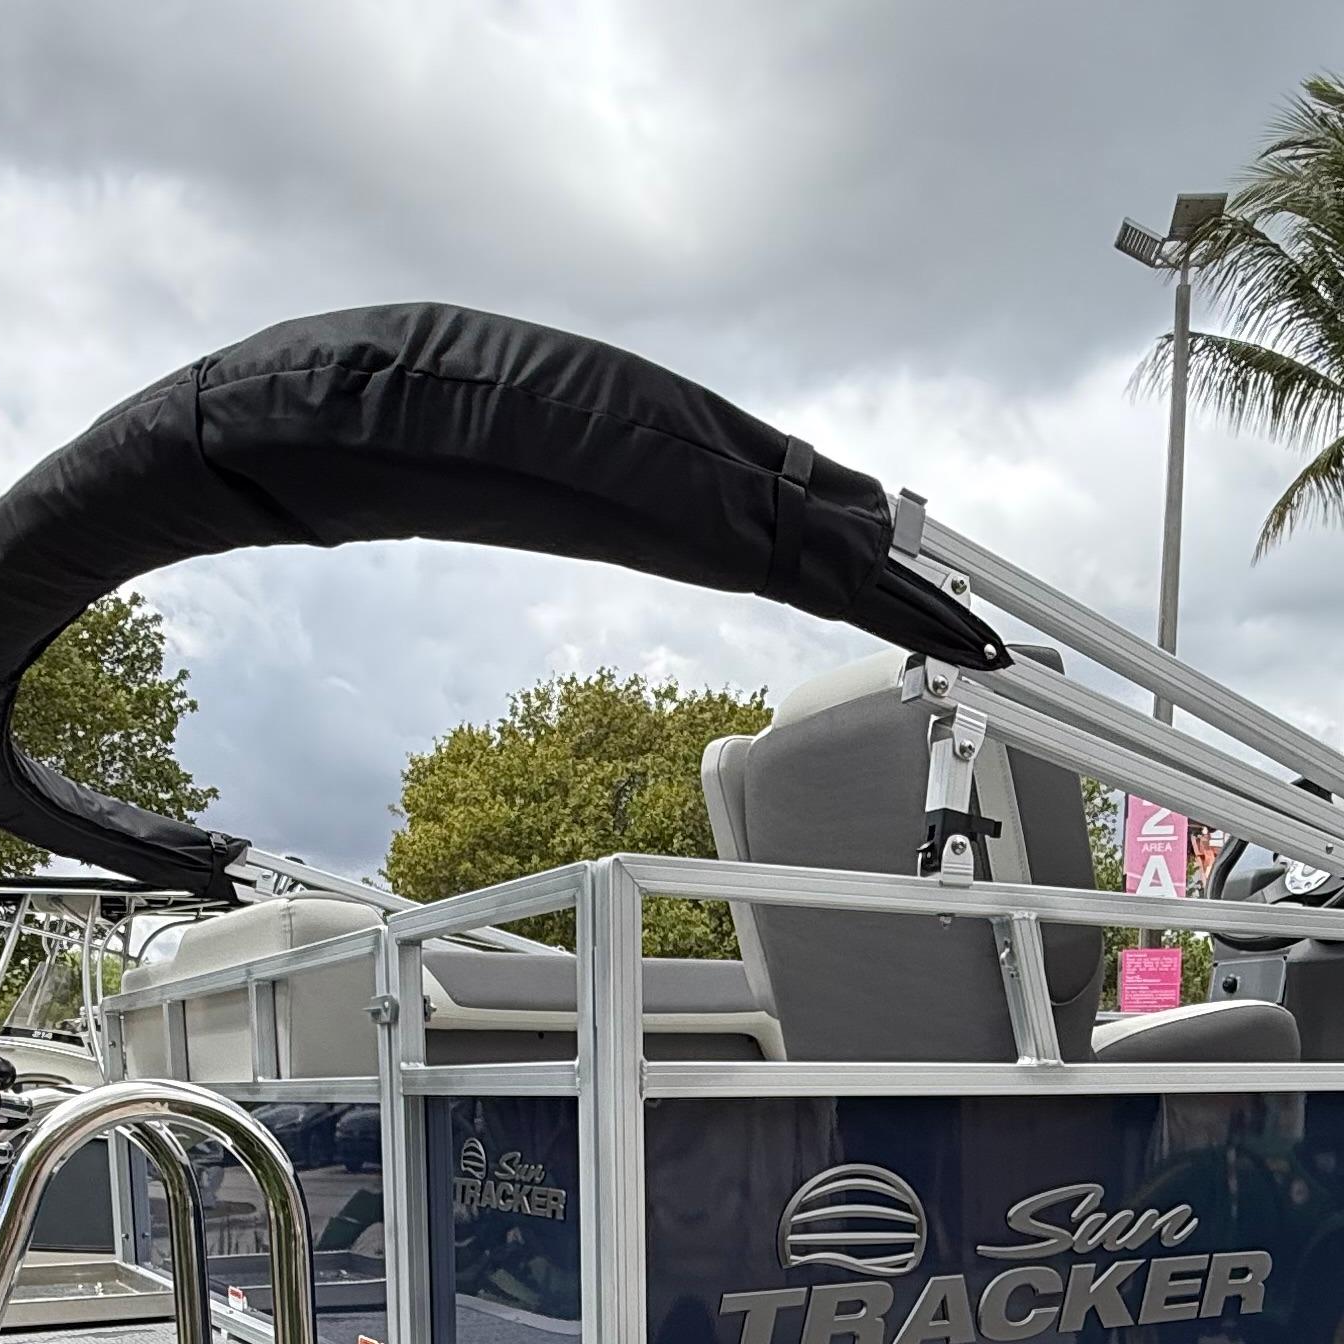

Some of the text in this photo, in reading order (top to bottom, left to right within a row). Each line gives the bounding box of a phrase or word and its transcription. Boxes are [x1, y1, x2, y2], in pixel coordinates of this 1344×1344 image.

[1142, 842, 1173, 853] AREA
[1135, 854, 1178, 898] A
[494, 1151, 545, 1184] Sun
[454, 1176, 567, 1221] TRACKER
[975, 1182, 1200, 1260] Sun
